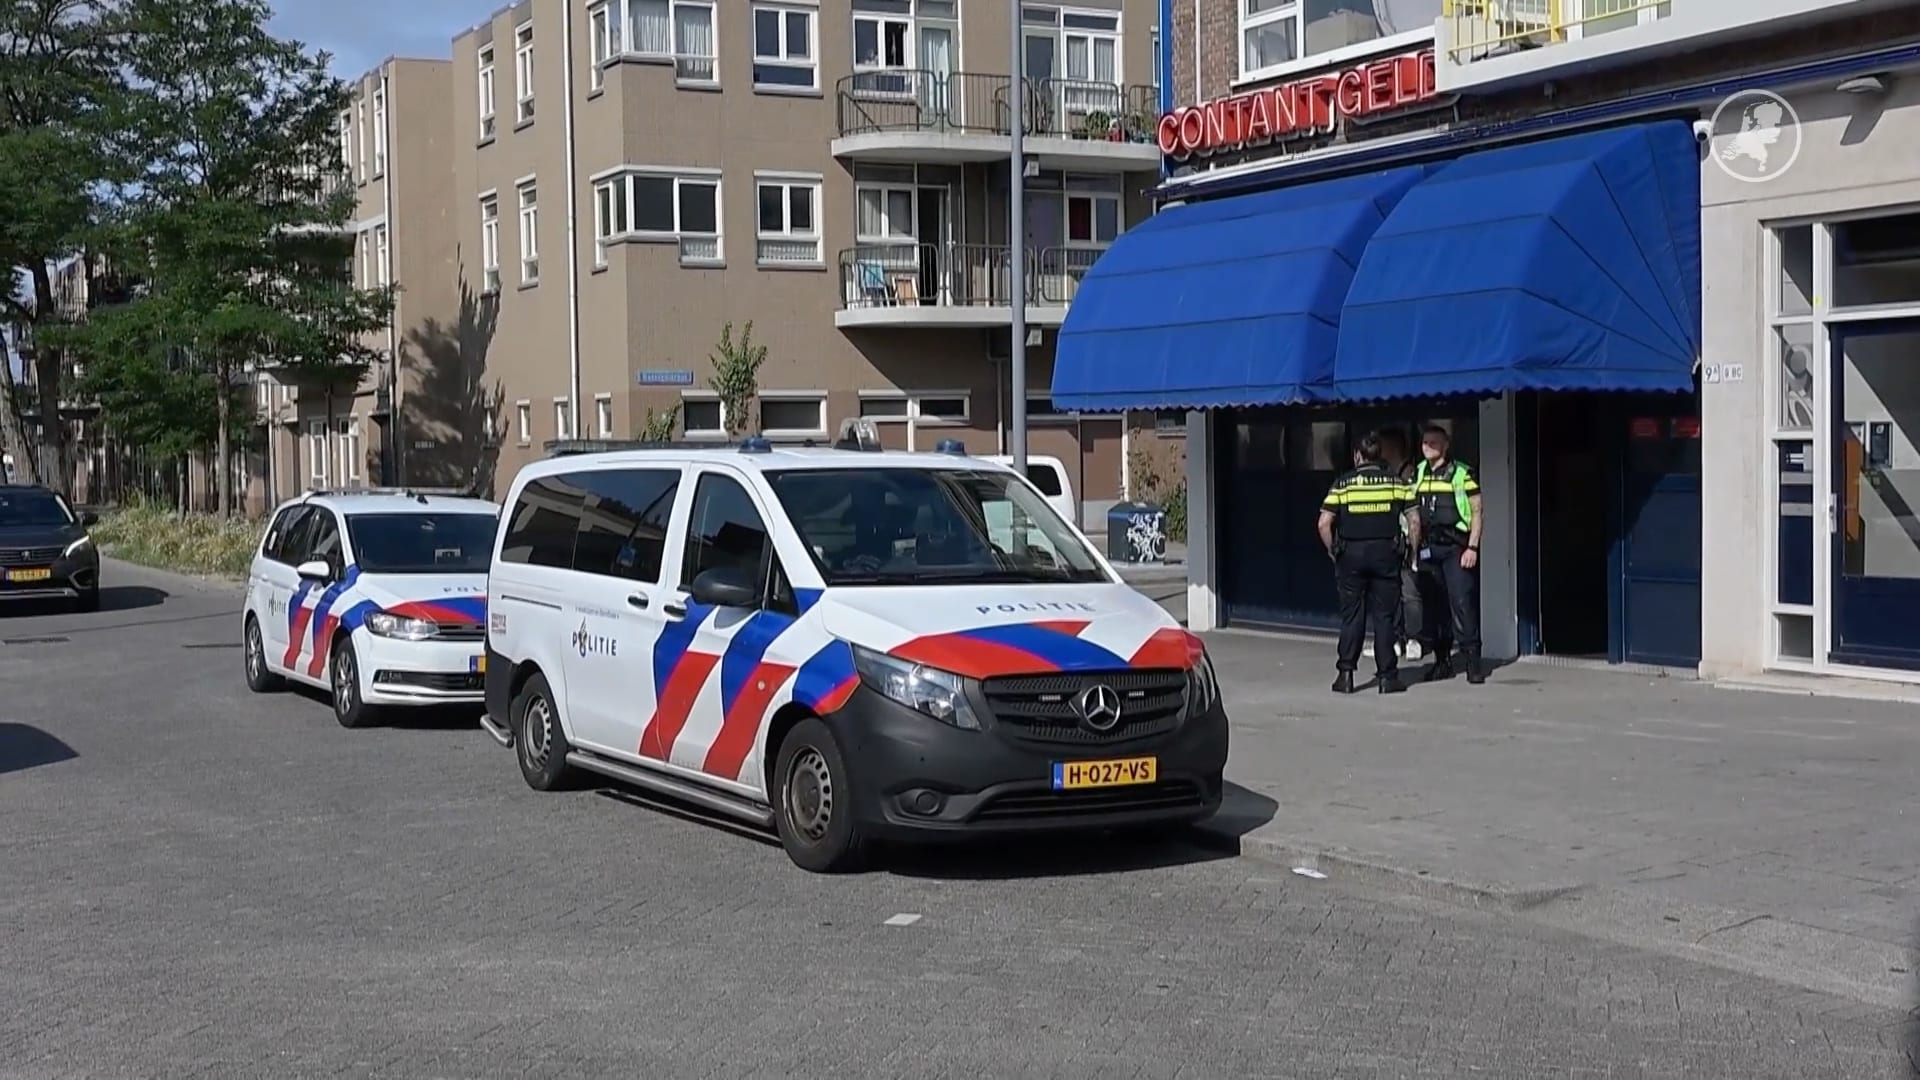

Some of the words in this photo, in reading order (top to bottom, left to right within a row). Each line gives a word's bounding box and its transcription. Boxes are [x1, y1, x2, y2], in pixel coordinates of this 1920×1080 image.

[1158, 77, 1333, 155] CONTANT
[976, 602, 1096, 614] POLITIE
[572, 627, 617, 657] POLITIE
[1069, 761, 1150, 784] H-027-VS
